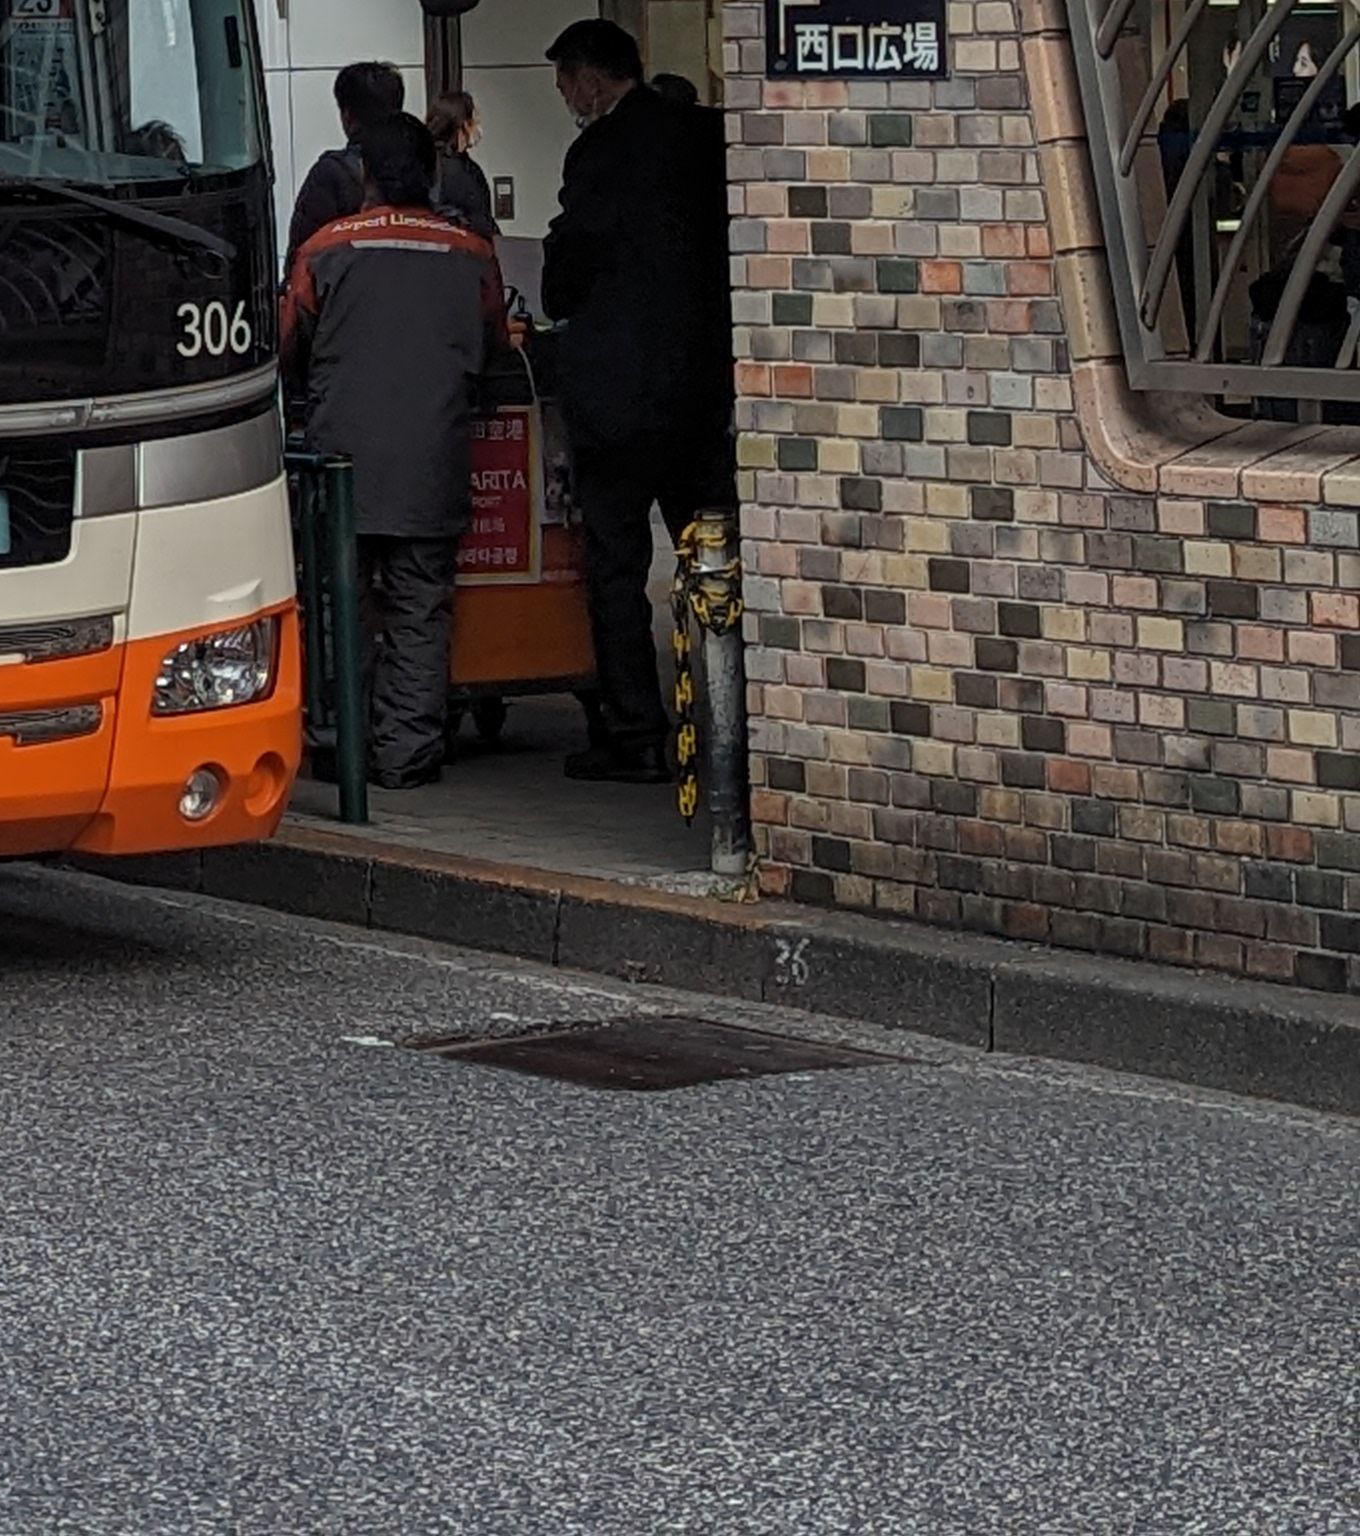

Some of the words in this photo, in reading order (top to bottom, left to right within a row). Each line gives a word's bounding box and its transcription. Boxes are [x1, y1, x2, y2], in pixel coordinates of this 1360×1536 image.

[794, 20, 940, 72] 西口広場
[174, 298, 253, 358] 306
